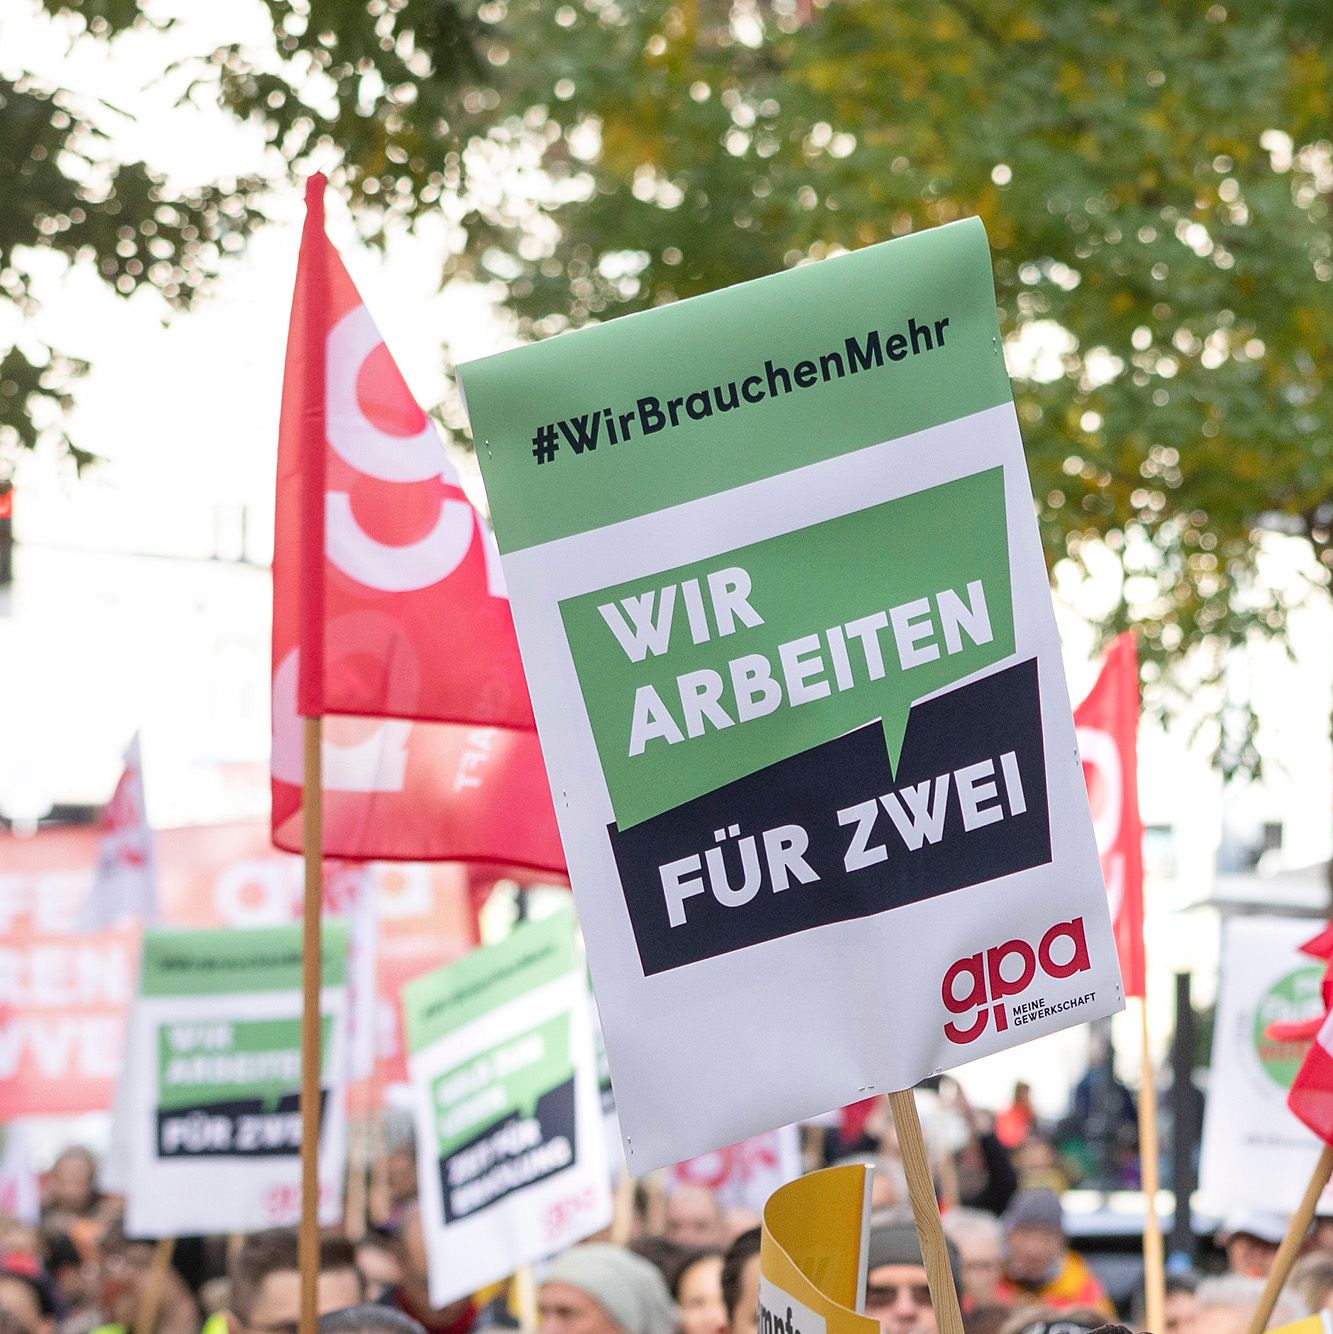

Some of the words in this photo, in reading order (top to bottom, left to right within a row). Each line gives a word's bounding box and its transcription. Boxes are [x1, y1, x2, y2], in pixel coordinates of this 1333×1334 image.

[530, 317, 951, 466] #WirBrauchenMehr
[596, 565, 767, 664] WIR
[627, 578, 995, 757] ARBEITEN
[658, 823, 822, 929] FÜR
[836, 750, 1028, 873] ZWEI
[941, 916, 1091, 1045] gpa
[1012, 997, 1046, 1017] MEINE
[1013, 991, 1096, 1027] GEWERKSCHAFT
